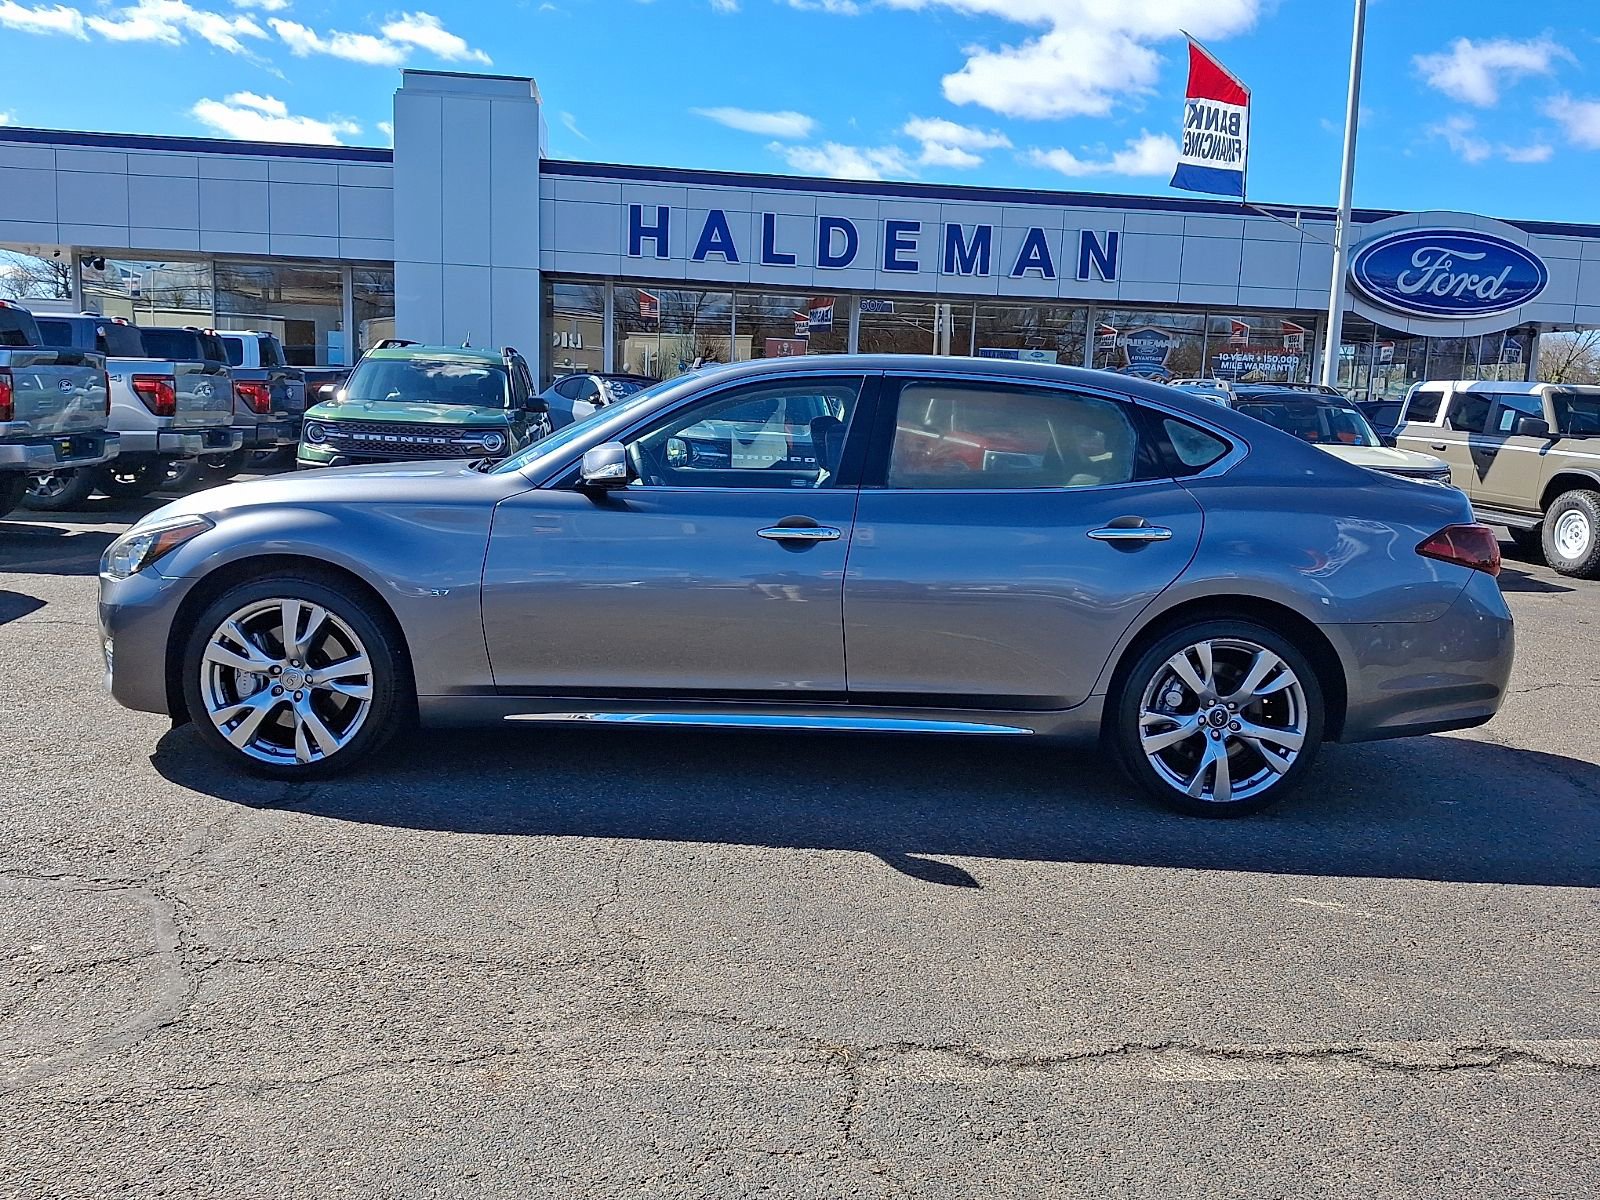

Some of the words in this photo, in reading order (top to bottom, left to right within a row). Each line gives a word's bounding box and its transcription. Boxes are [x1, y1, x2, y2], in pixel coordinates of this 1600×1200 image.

[627, 203, 1119, 282] HALDEMAN
[1397, 246, 1512, 300] Ford
[1219, 353, 1254, 362] 10-YEAR
[1263, 355, 1298, 365] 150,000
[1220, 361, 1243, 370] MILE
[1244, 362, 1296, 372] WARRANTY
[353, 434, 445, 444] BRONCO
